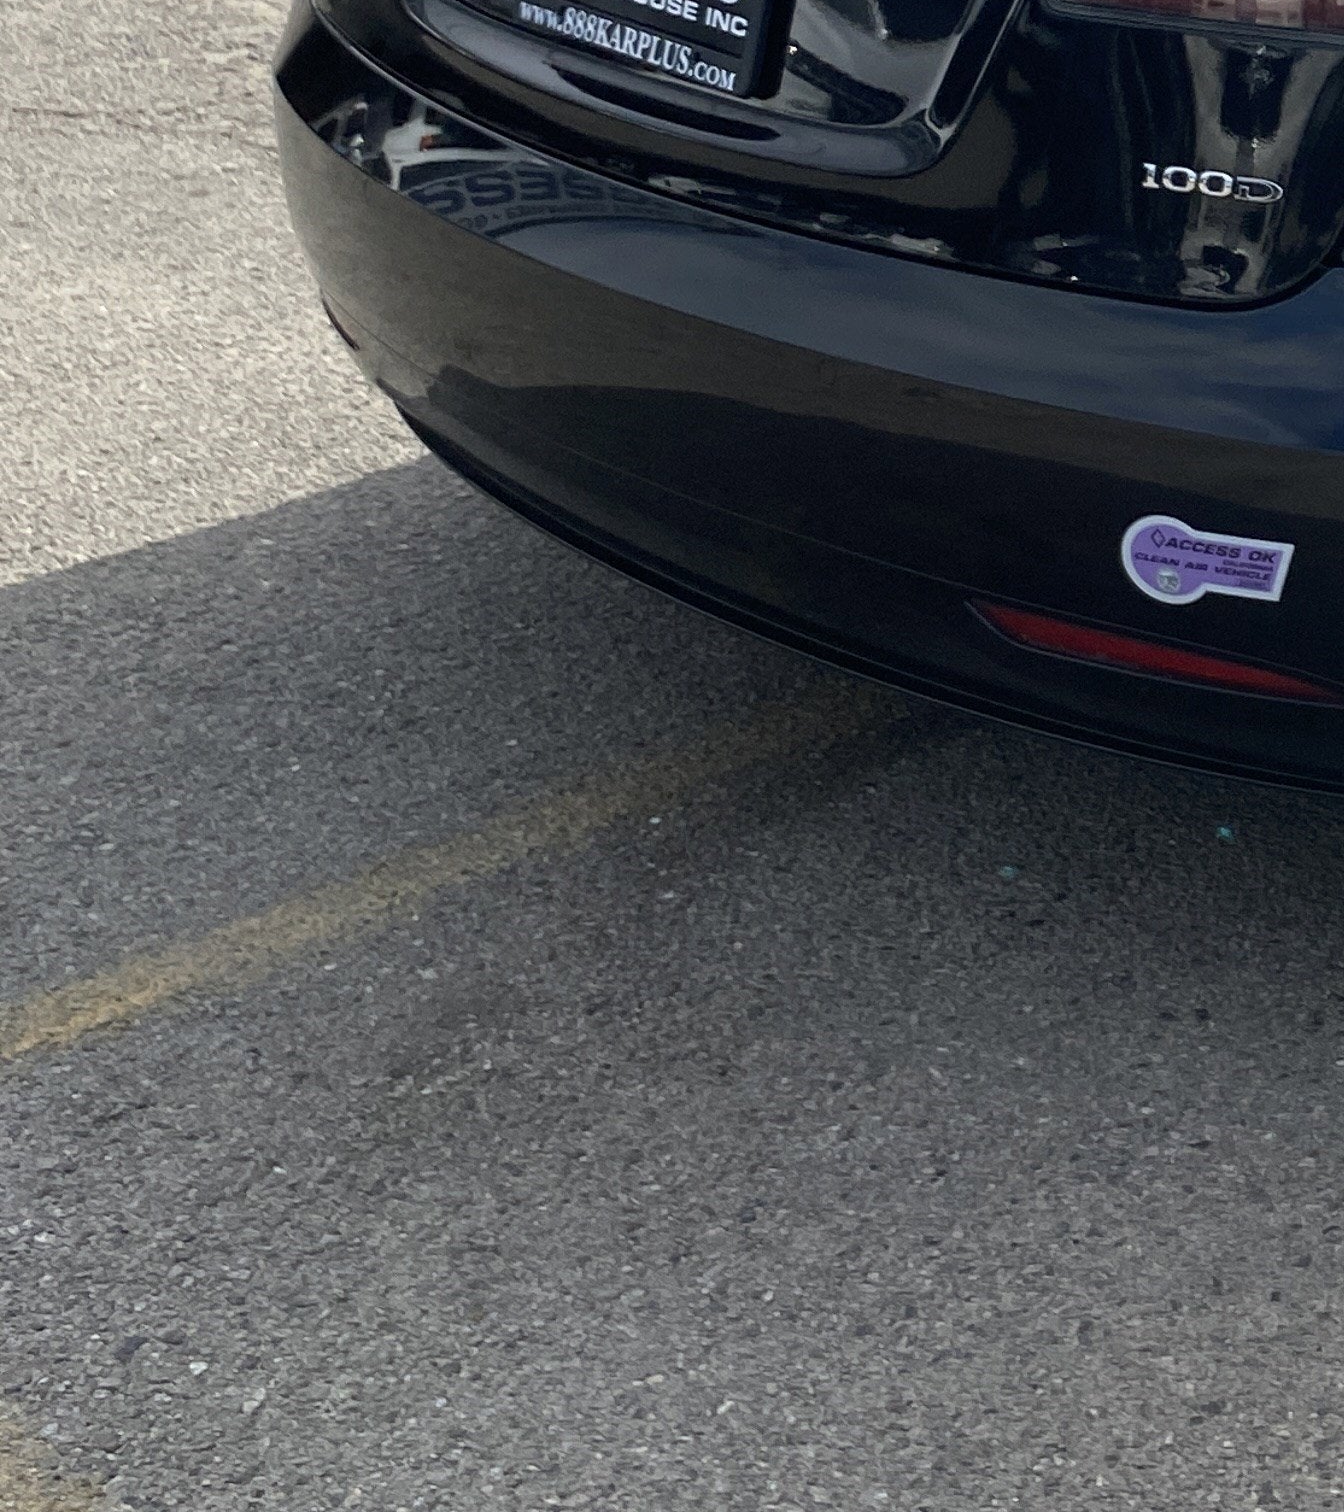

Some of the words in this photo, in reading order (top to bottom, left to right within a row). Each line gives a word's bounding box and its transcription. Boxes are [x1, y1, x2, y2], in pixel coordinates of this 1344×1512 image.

[704, 6, 749, 37] INC
[1141, 162, 1284, 204] 100D
[1164, 537, 1242, 559] ACCESS
[1248, 549, 1277, 564] OK
[1134, 551, 1180, 567] CLEAN
[1184, 560, 1209, 572] AIR
[1214, 566, 1272, 582] VEHICLE
